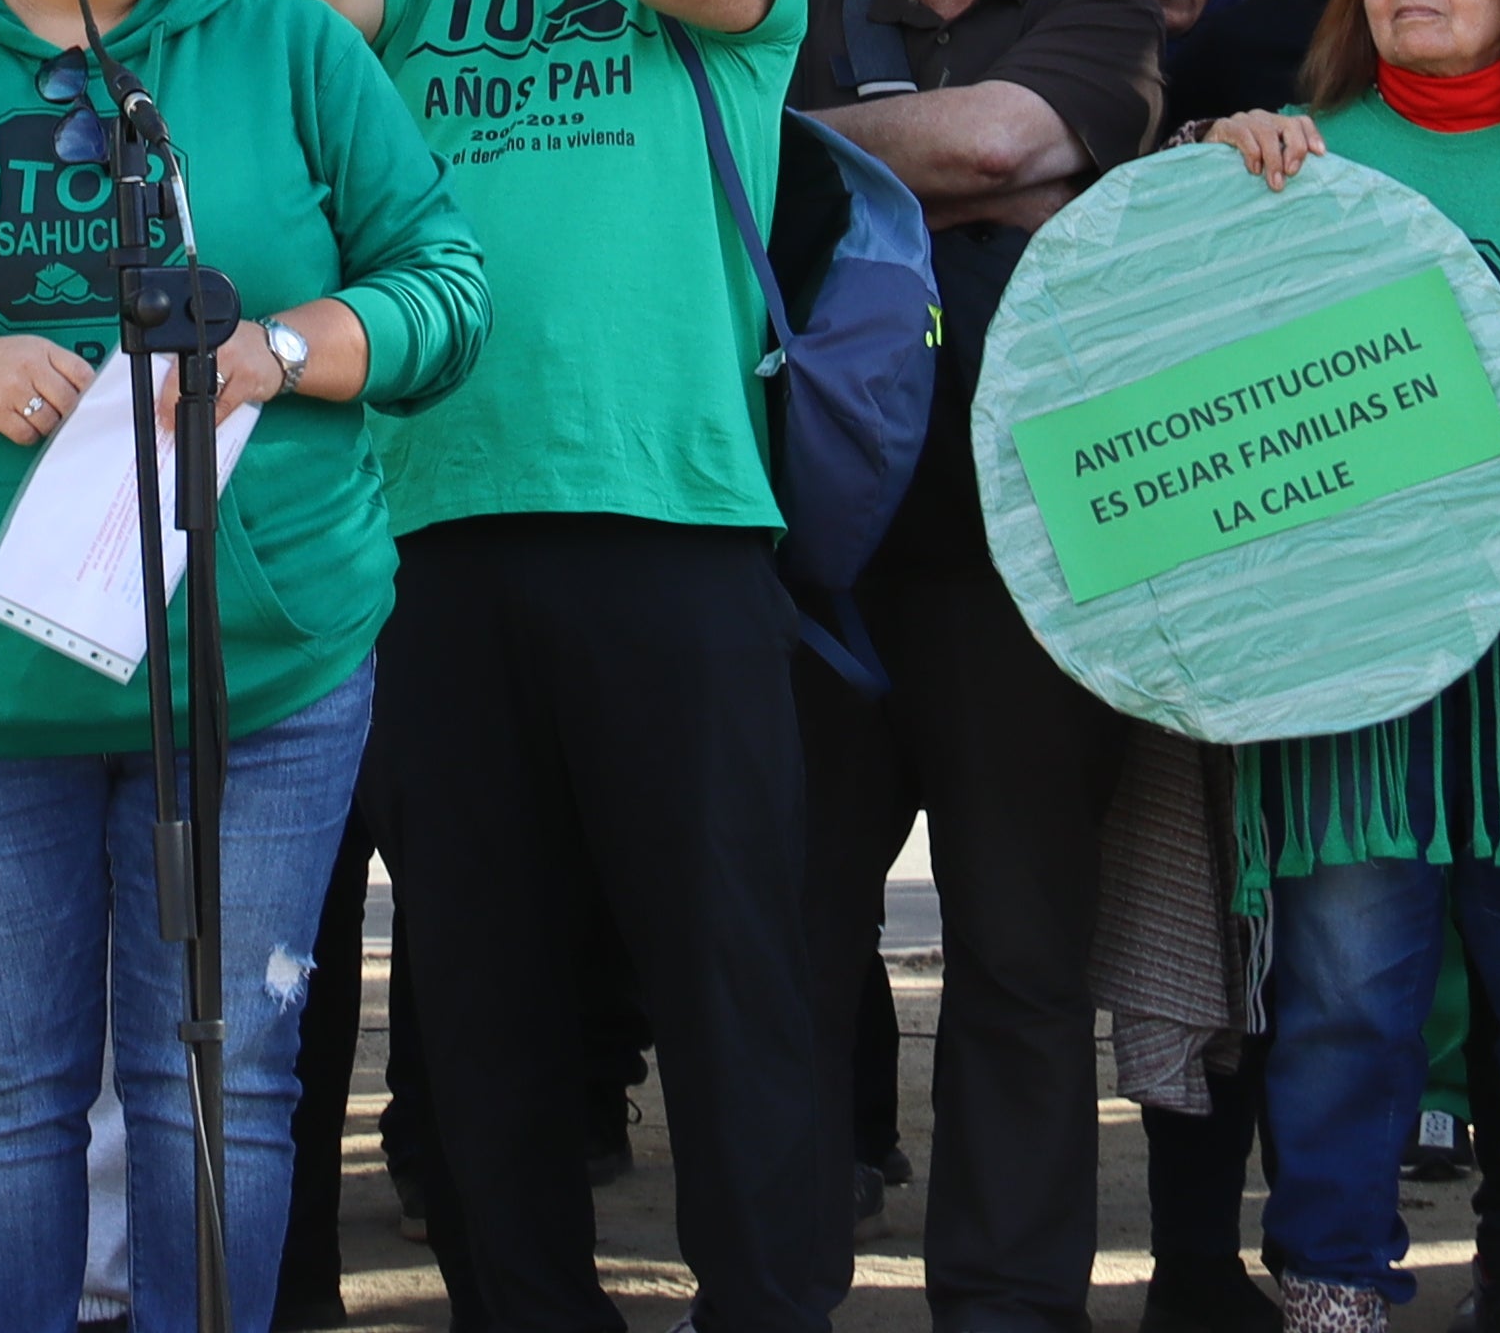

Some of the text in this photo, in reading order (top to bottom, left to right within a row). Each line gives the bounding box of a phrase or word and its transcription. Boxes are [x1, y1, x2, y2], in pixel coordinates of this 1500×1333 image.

[424, 54, 633, 119] AÑOS PAH
[546, 135, 562, 151] la
[567, 129, 636, 148] vivienda
[1072, 326, 1423, 477] ANTICONSTITUCIONAL
[1090, 373, 1441, 525] ES DEJAR FAMILIAS EN
[1213, 459, 1355, 534] LA CALLE
